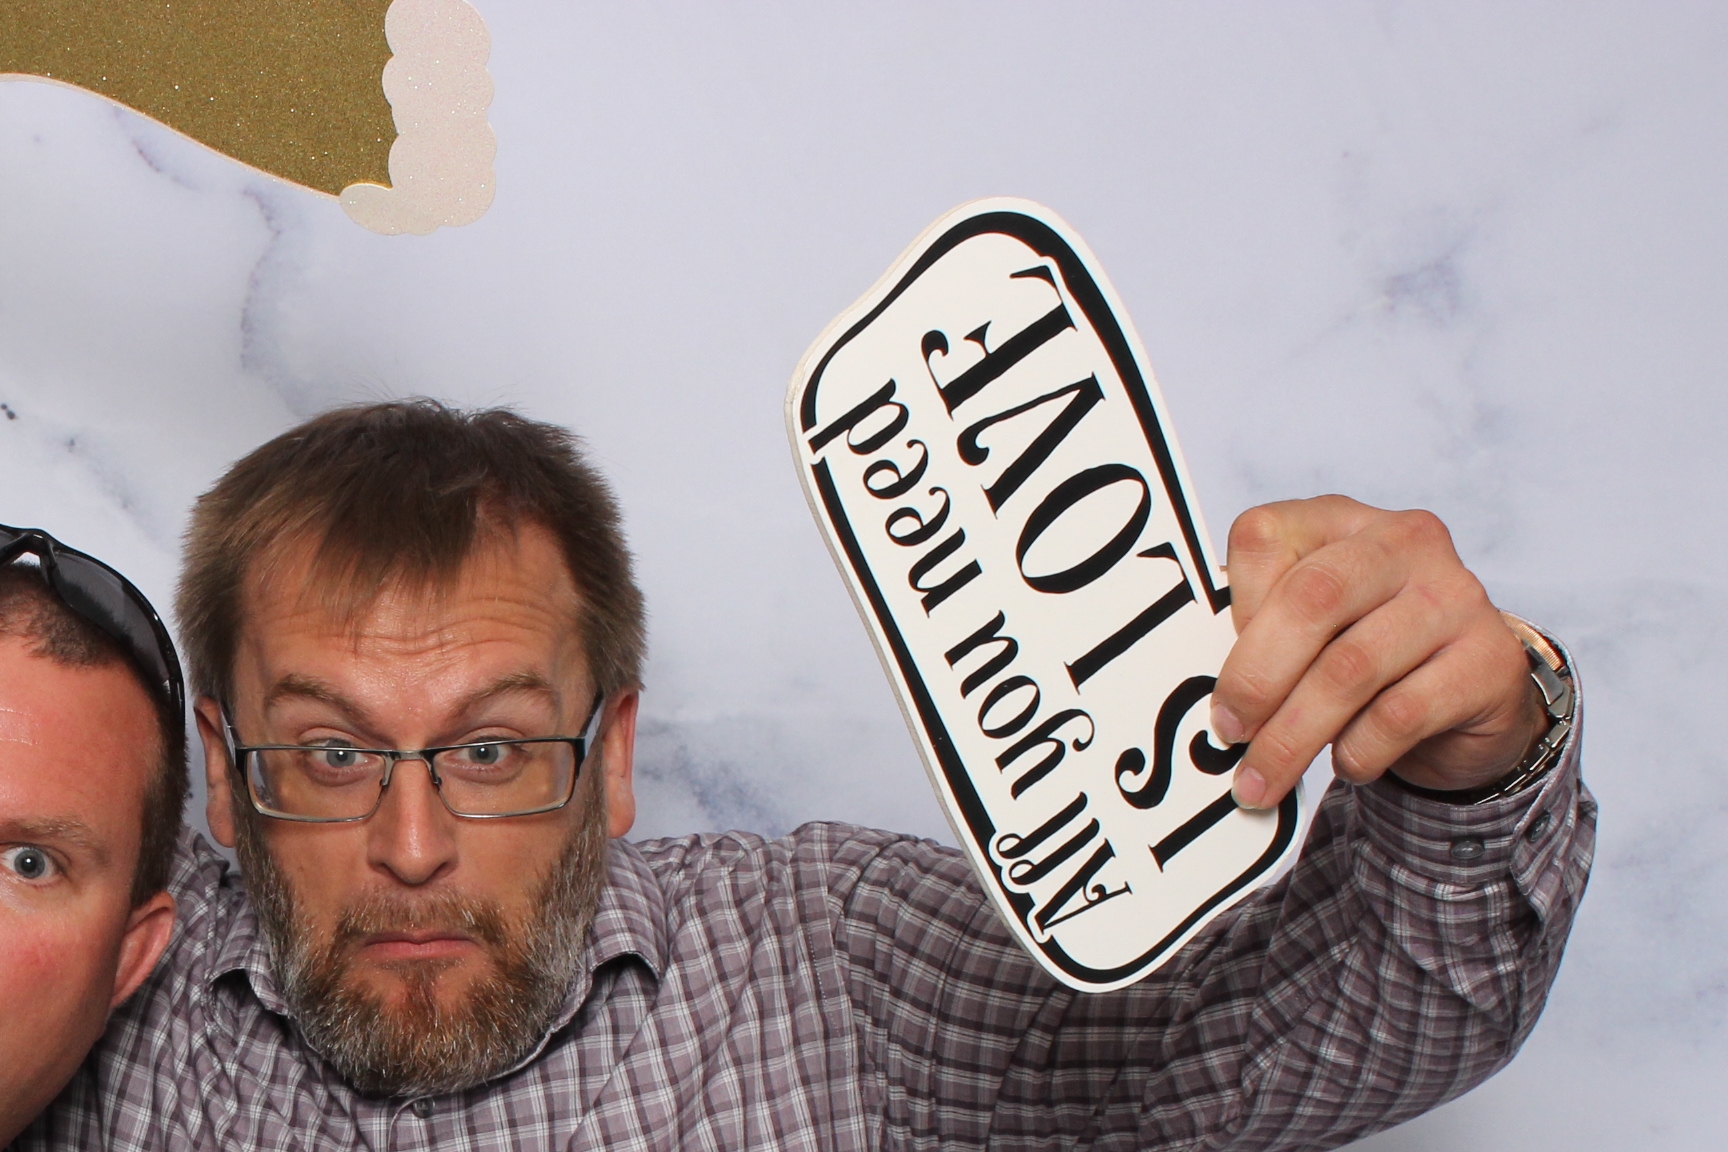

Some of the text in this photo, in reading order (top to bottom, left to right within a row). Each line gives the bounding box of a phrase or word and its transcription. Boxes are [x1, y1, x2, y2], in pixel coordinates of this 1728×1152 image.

[807, 378, 1133, 935] All you need
[920, 264, 1251, 873] IS LOVE
